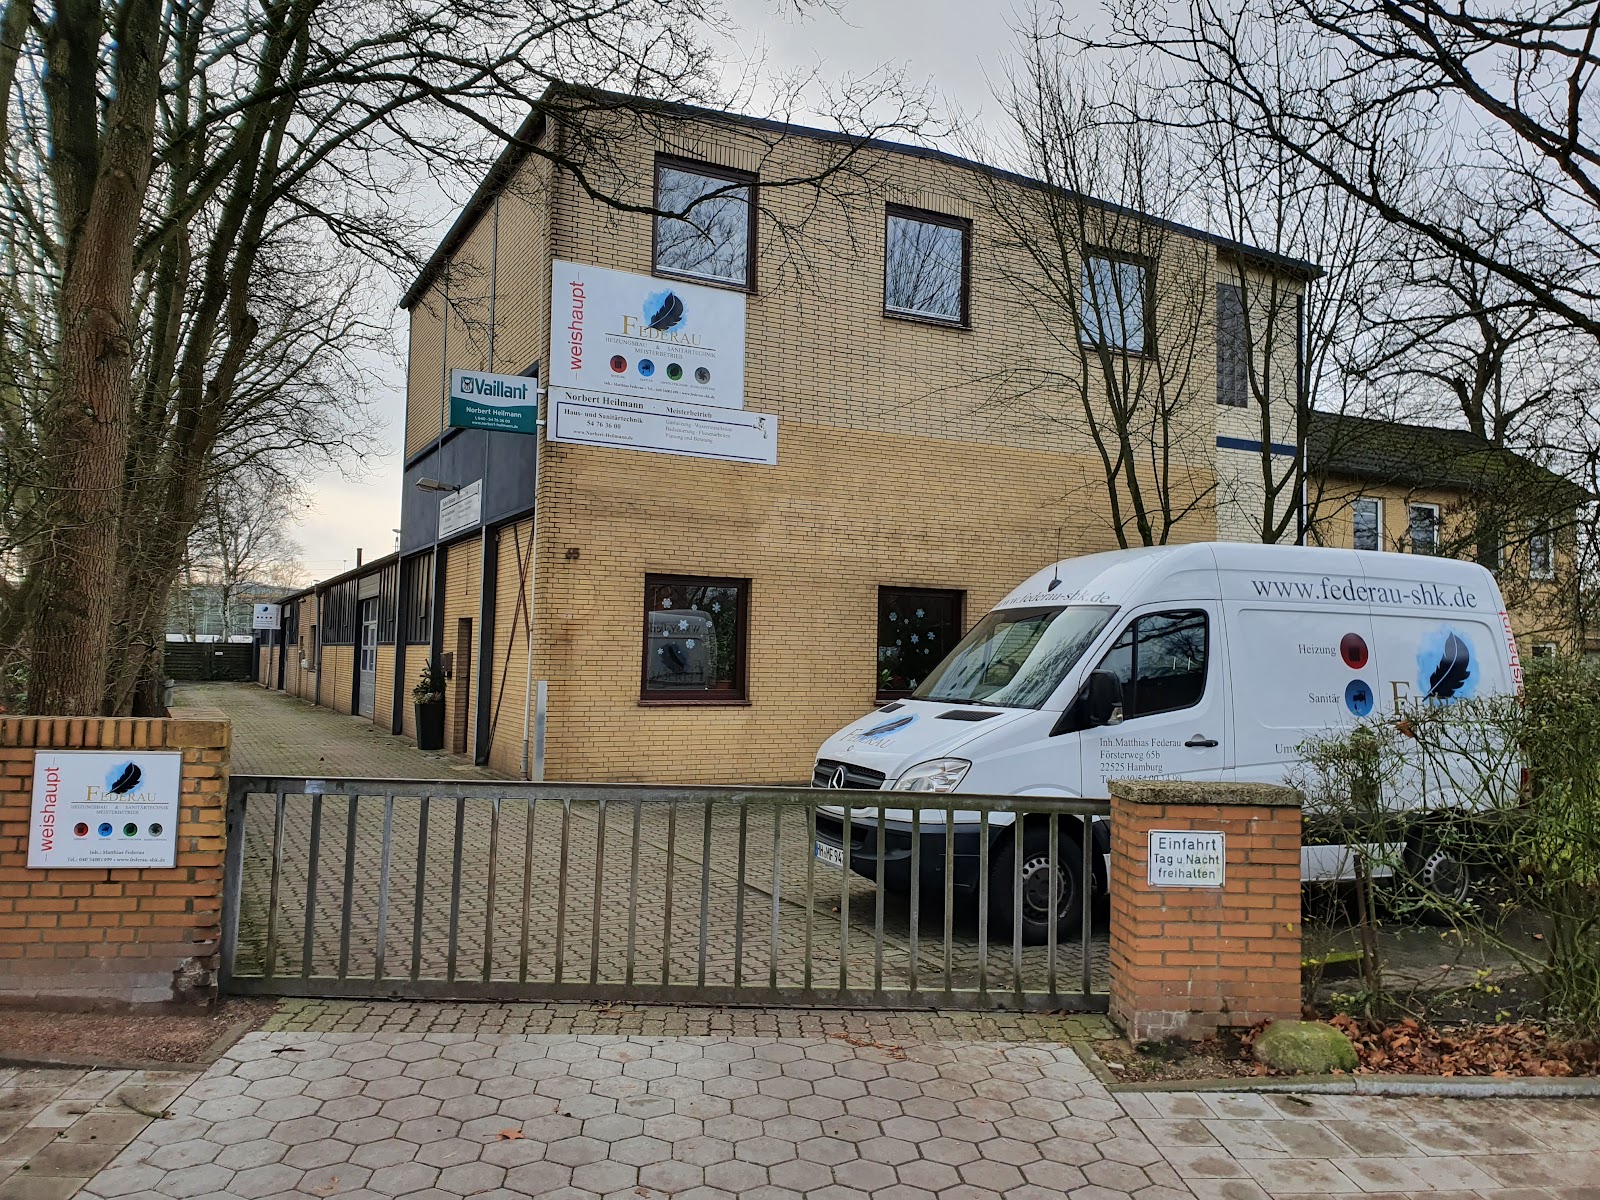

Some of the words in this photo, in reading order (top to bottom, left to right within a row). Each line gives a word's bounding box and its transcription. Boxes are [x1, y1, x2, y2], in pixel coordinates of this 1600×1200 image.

[568, 281, 586, 370] weishaupt
[475, 378, 528, 400] Vaillant
[565, 391, 600, 404] Norbert
[602, 396, 644, 409] Heilmann
[665, 406, 712, 418] Meisterbetrieb
[466, 406, 491, 415] Norbert
[492, 409, 522, 418] Heilmann
[598, 412, 644, 423] Sanitärtechnik
[1251, 577, 1478, 608] www.federau-shk.de
[1298, 643, 1337, 656] Heizung
[1308, 692, 1341, 704] Sanitär
[1151, 738, 1182, 747] Federau
[1100, 750, 1144, 761] Försterweg
[1145, 750, 1161, 759] 65b
[1100, 763, 1125, 772] 22525
[1127, 762, 1163, 773] Hamburg
[40, 767, 60, 851] weishaupt
[1159, 837, 1216, 851] Einfahrt
[1154, 853, 1173, 866] Tag
[1186, 854, 1220, 865] Nacht
[1158, 868, 1216, 879] freihalten
